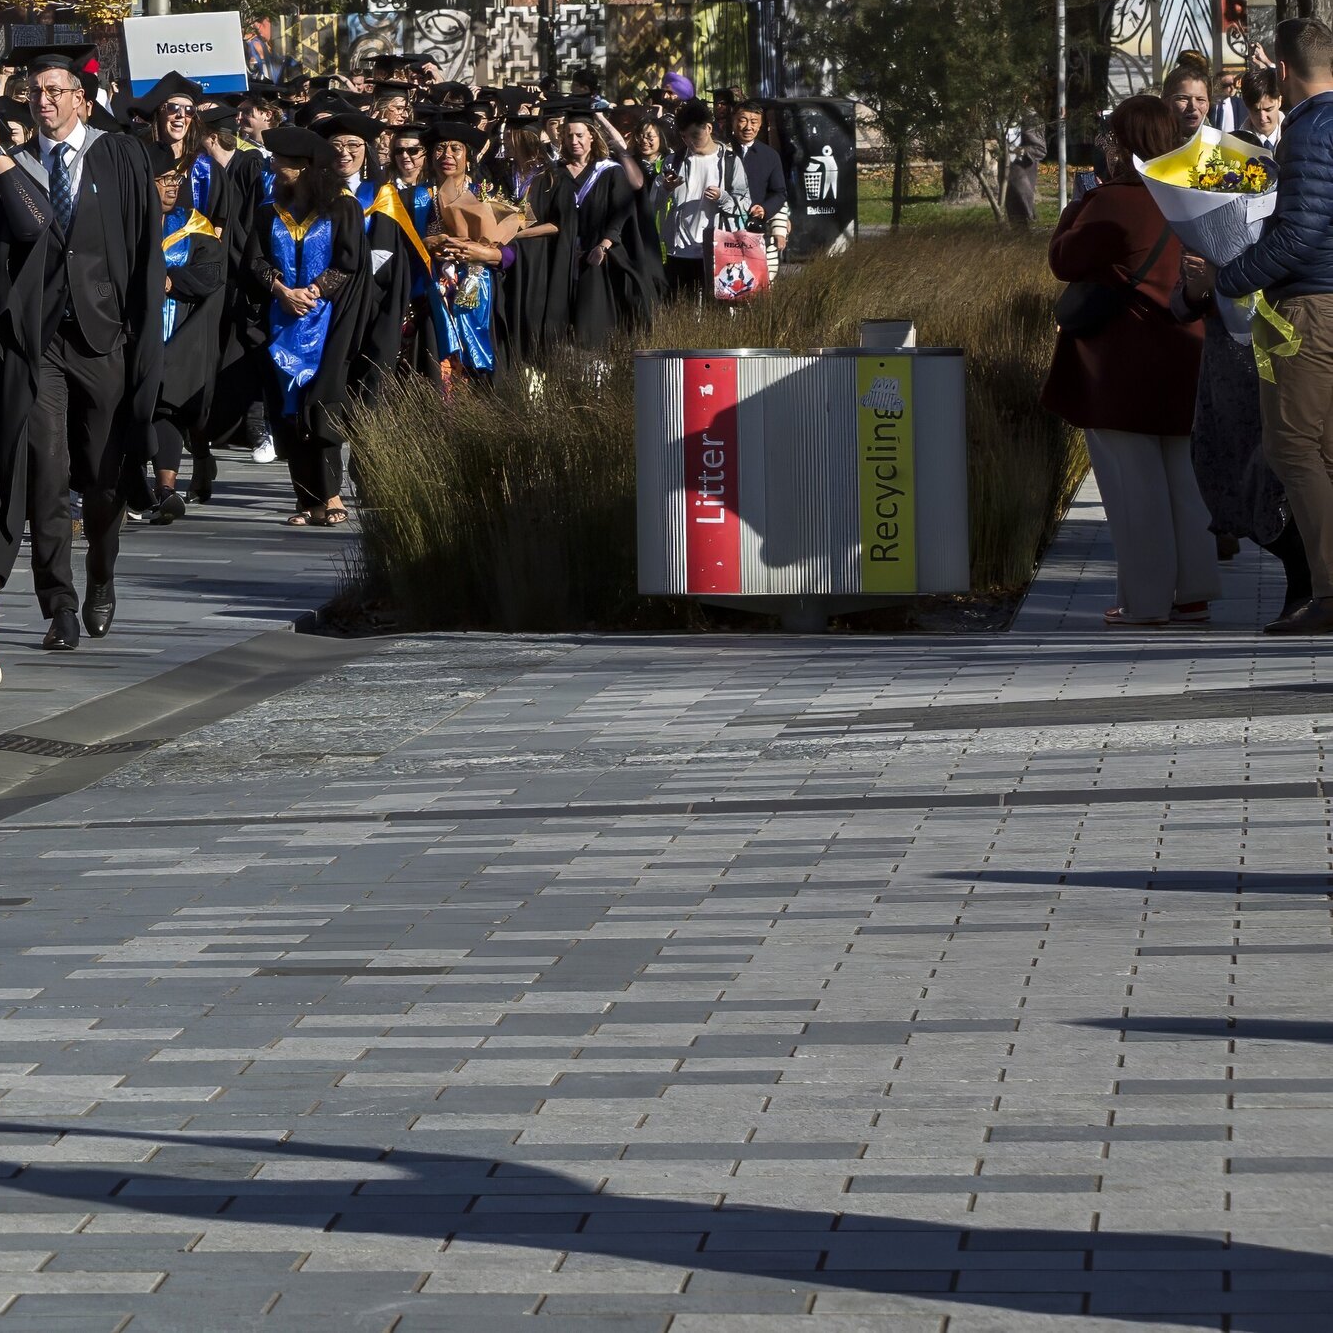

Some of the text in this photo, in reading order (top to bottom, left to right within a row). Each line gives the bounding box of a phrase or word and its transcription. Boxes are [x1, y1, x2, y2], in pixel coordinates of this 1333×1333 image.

[156, 42, 214, 55] Masters
[695, 433, 725, 525] Litter
[866, 407, 905, 562] Recycling
